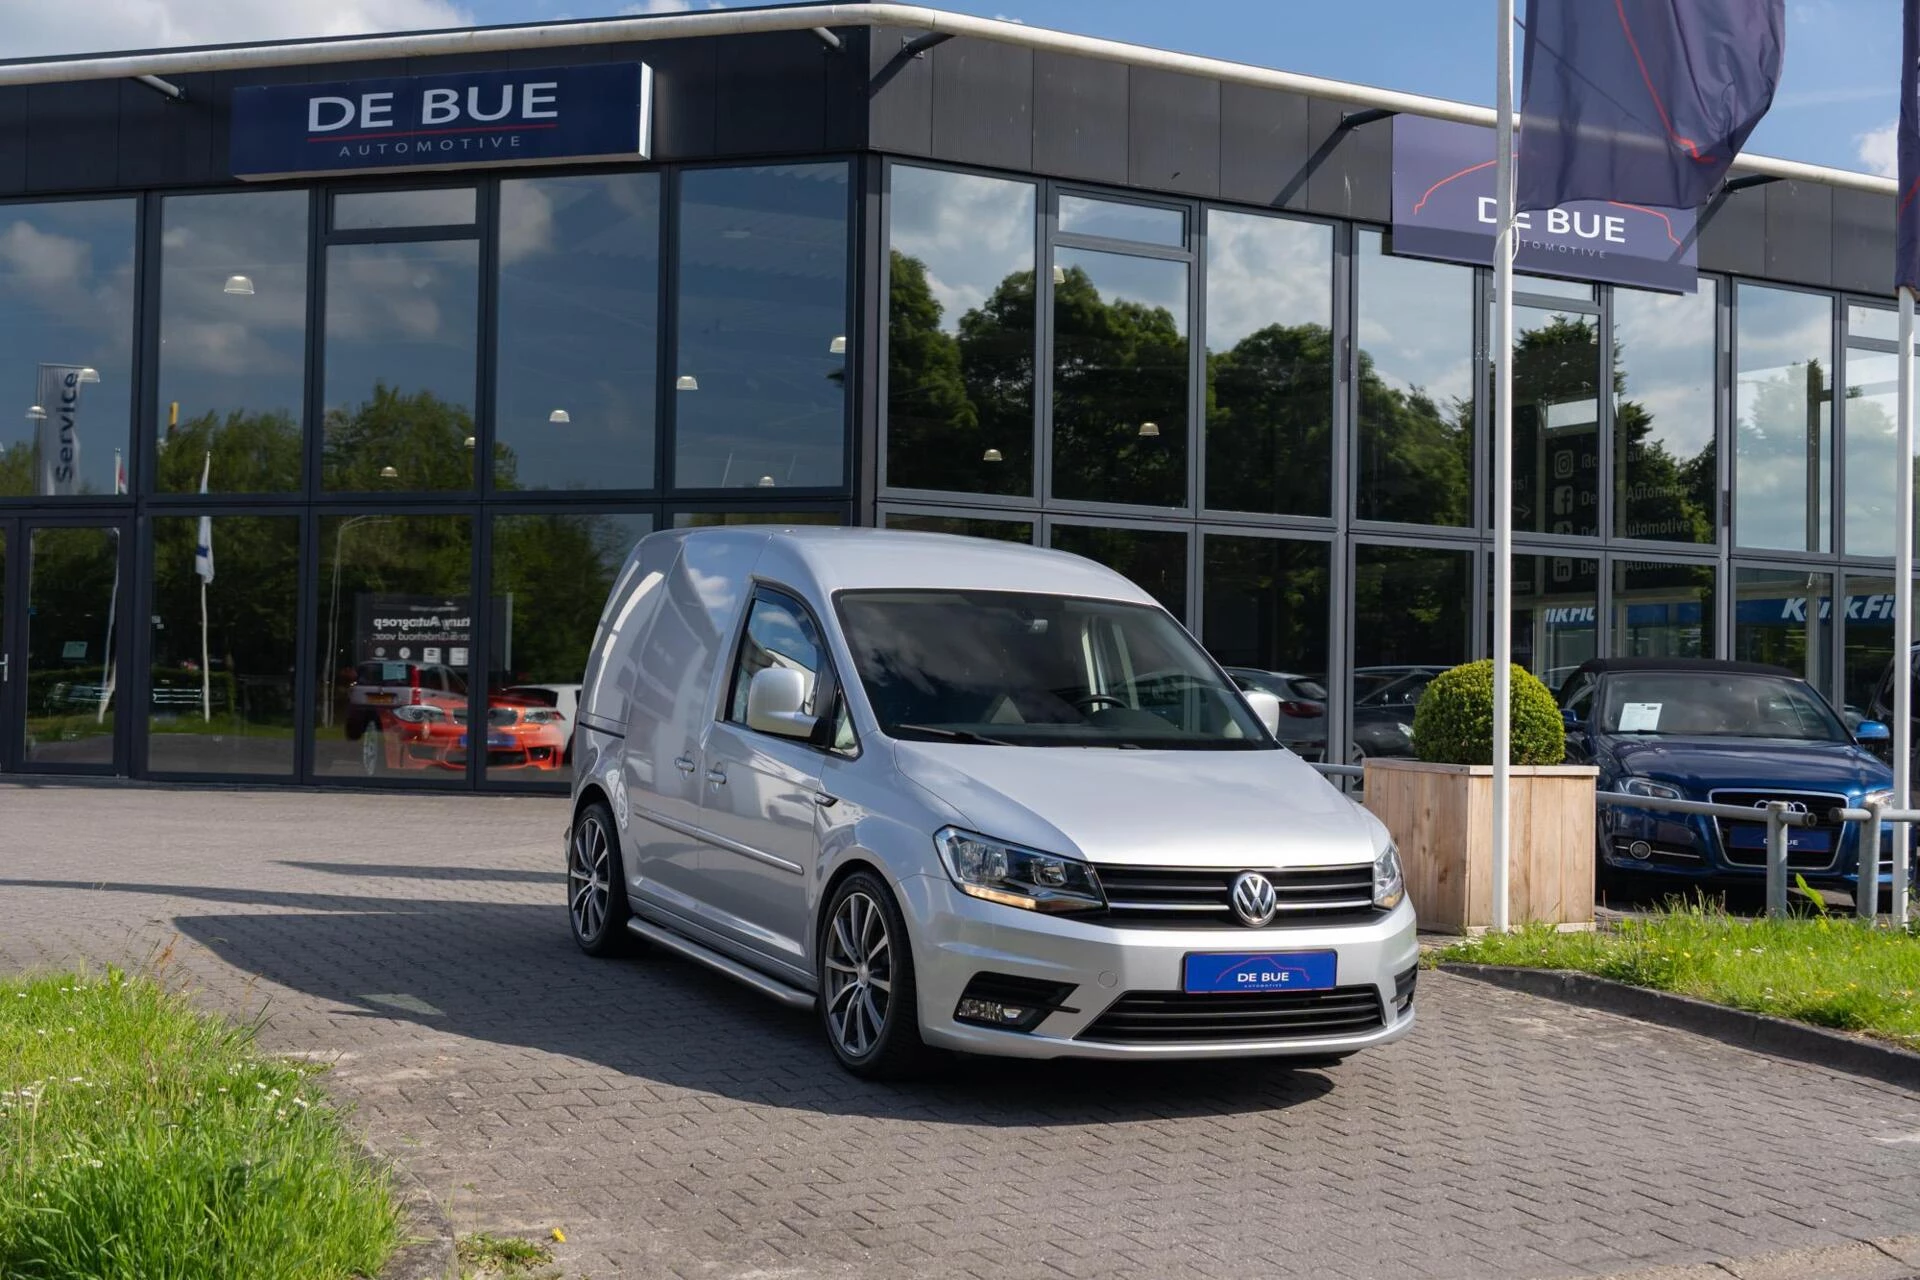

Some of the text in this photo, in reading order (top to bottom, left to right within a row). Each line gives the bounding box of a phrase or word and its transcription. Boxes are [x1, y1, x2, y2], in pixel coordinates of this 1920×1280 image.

[308, 82, 558, 132] DE BUE
[339, 135, 521, 157] AUTOMOTIVE
[1547, 208, 1625, 243] BUE
[1512, 240, 1607, 259] TOMOTIVE
[56, 373, 79, 483] Service
[1237, 972, 1290, 983] DE BUE
